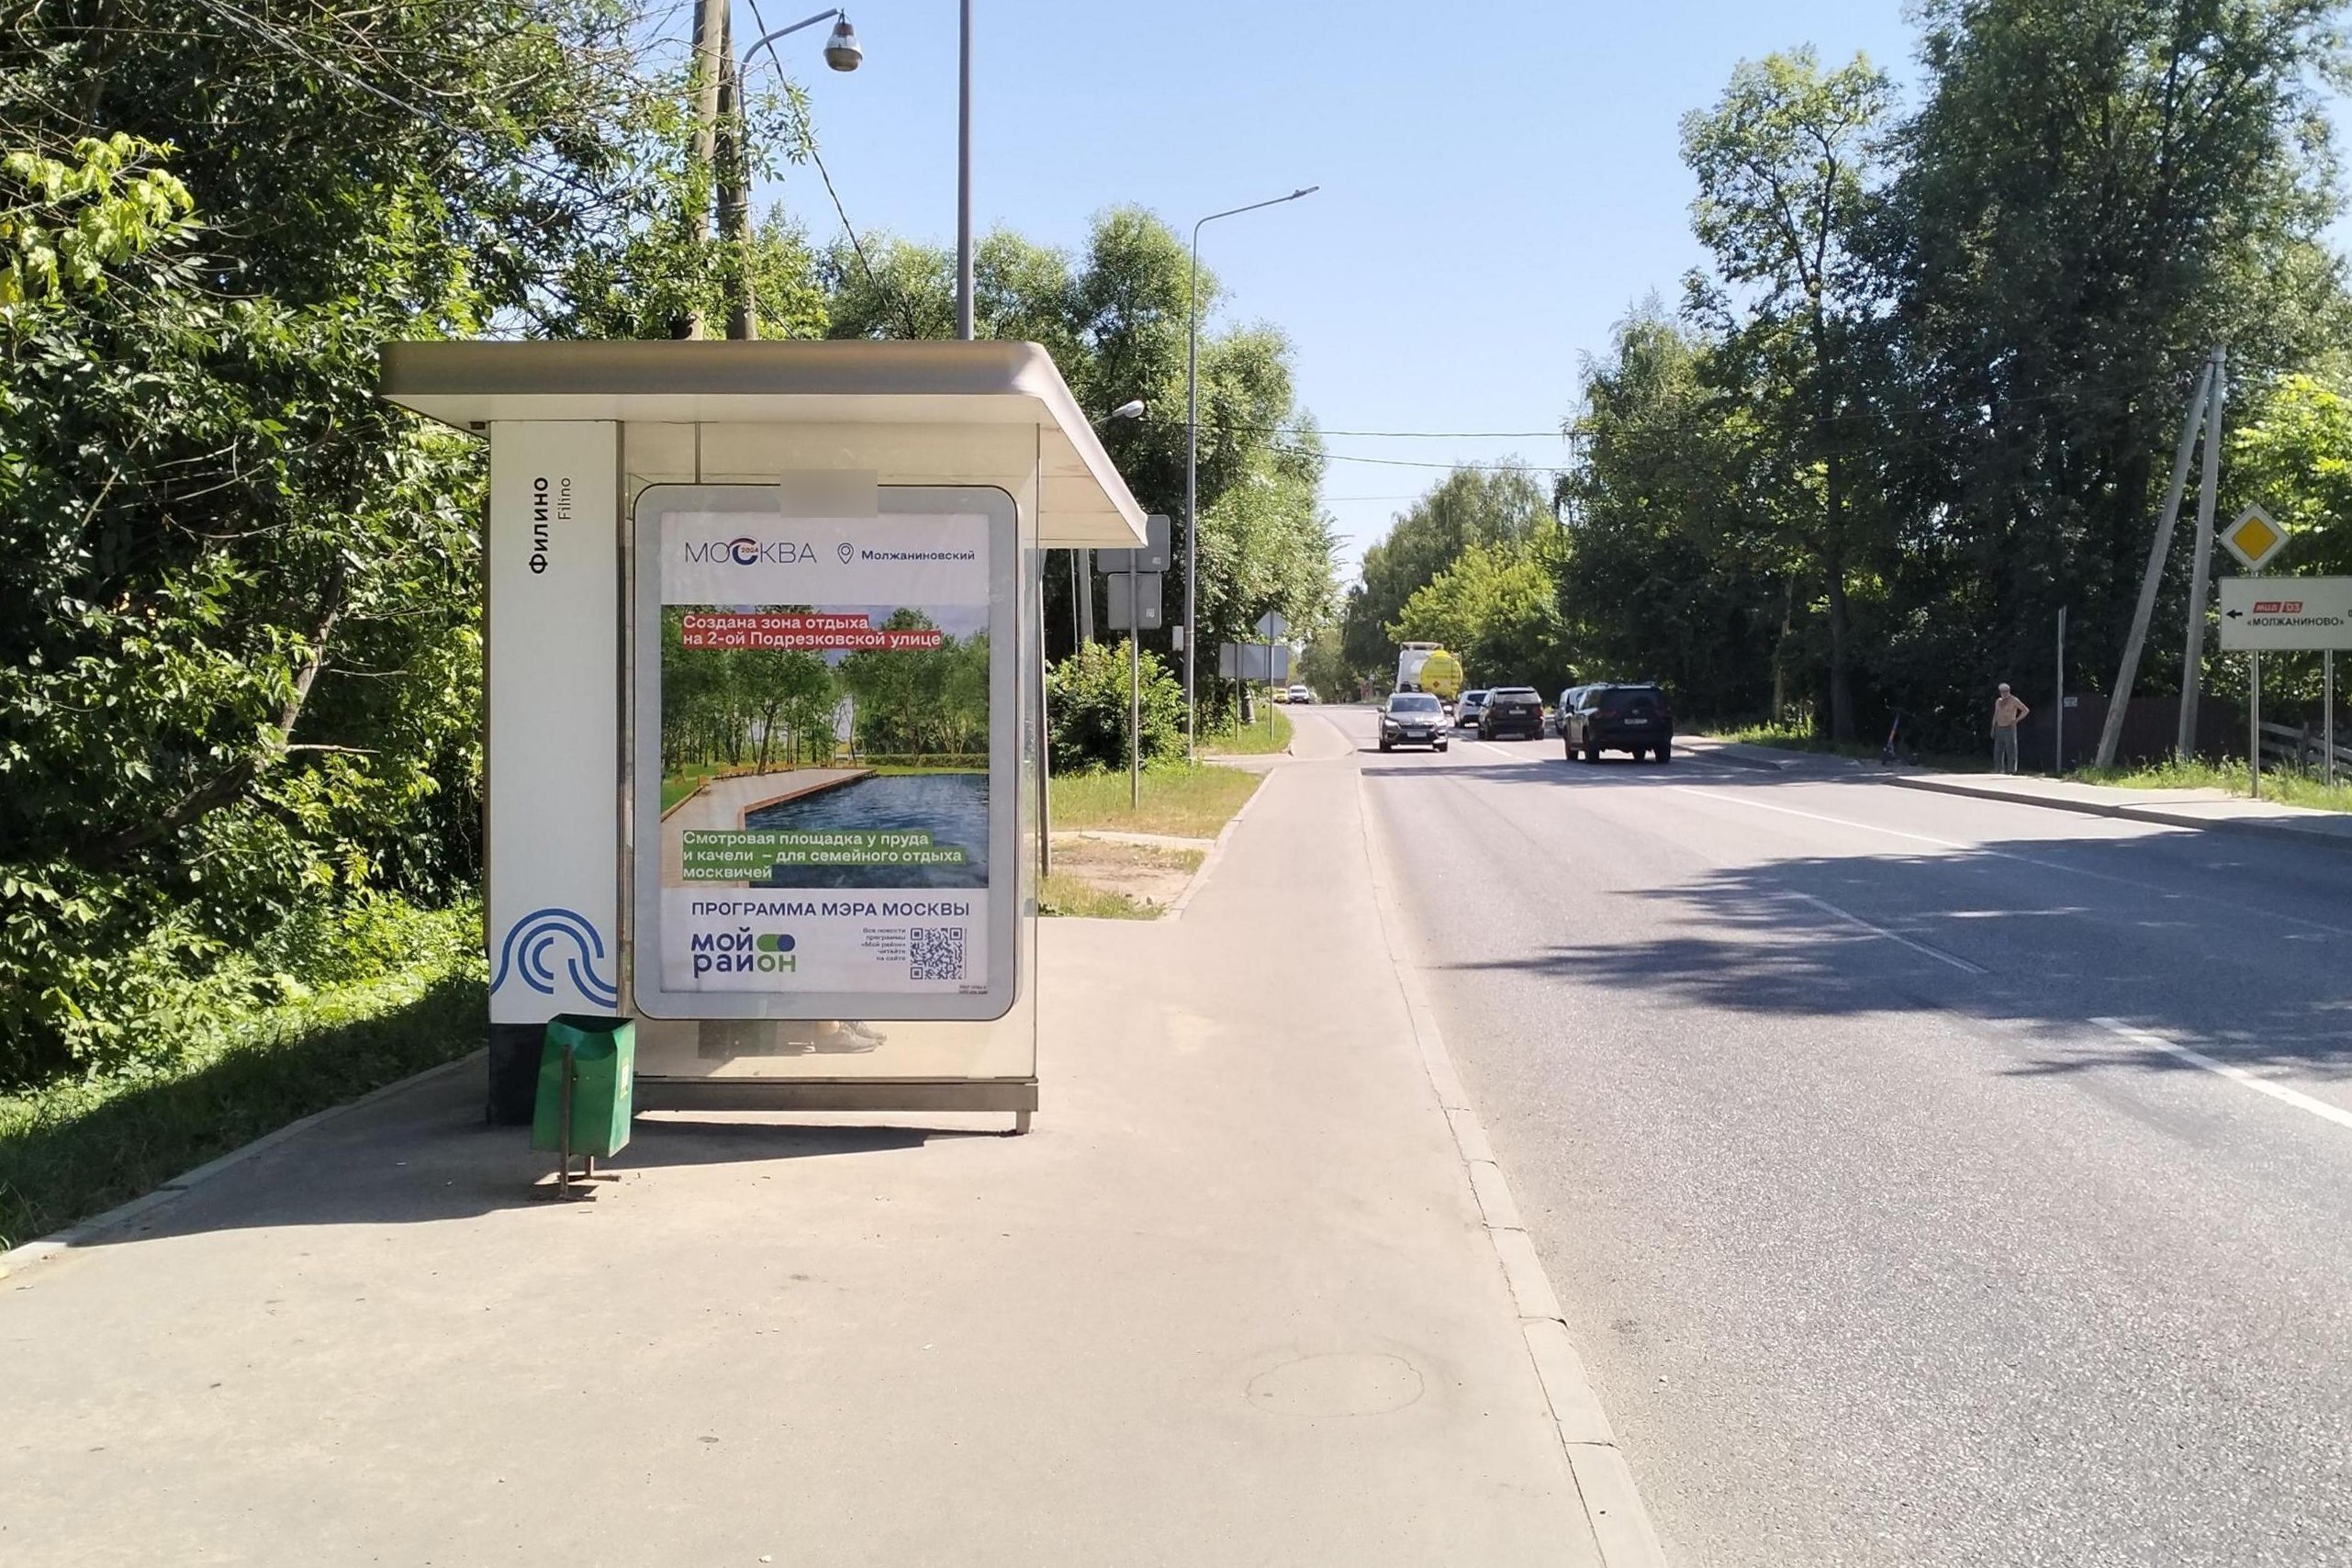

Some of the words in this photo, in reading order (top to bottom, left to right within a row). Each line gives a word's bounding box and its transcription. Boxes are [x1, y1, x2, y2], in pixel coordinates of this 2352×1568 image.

[557, 477, 571, 520] Filino
[529, 477, 548, 574] Филино
[685, 537, 817, 566] МОСКВА
[861, 550, 975, 561] Молжаниновский
[683, 615, 756, 630] Создана
[761, 619, 801, 629] зона
[805, 619, 868, 630] отдыха
[2247, 617, 2344, 626] «МОЛЖАНИНОВО»
[683, 635, 702, 645] на
[707, 631, 745, 645] 2-ой
[750, 631, 885, 648] Подрезковской
[890, 635, 941, 647] улице
[683, 831, 775, 846] Смотровая
[779, 834, 862, 847] площадка
[868, 834, 877, 846] у
[881, 834, 929, 846] пруда
[683, 851, 692, 861] и
[697, 851, 753, 861] качели
[776, 851, 806, 862] для
[810, 848, 898, 861] семейного
[902, 851, 962, 862] отдыха
[683, 865, 772, 878] москвичей
[691, 902, 816, 915] ПРОГРАММА
[822, 902, 878, 915] МЭРА
[882, 902, 969, 915] МОСКВЫ
[690, 926, 754, 951] мой
